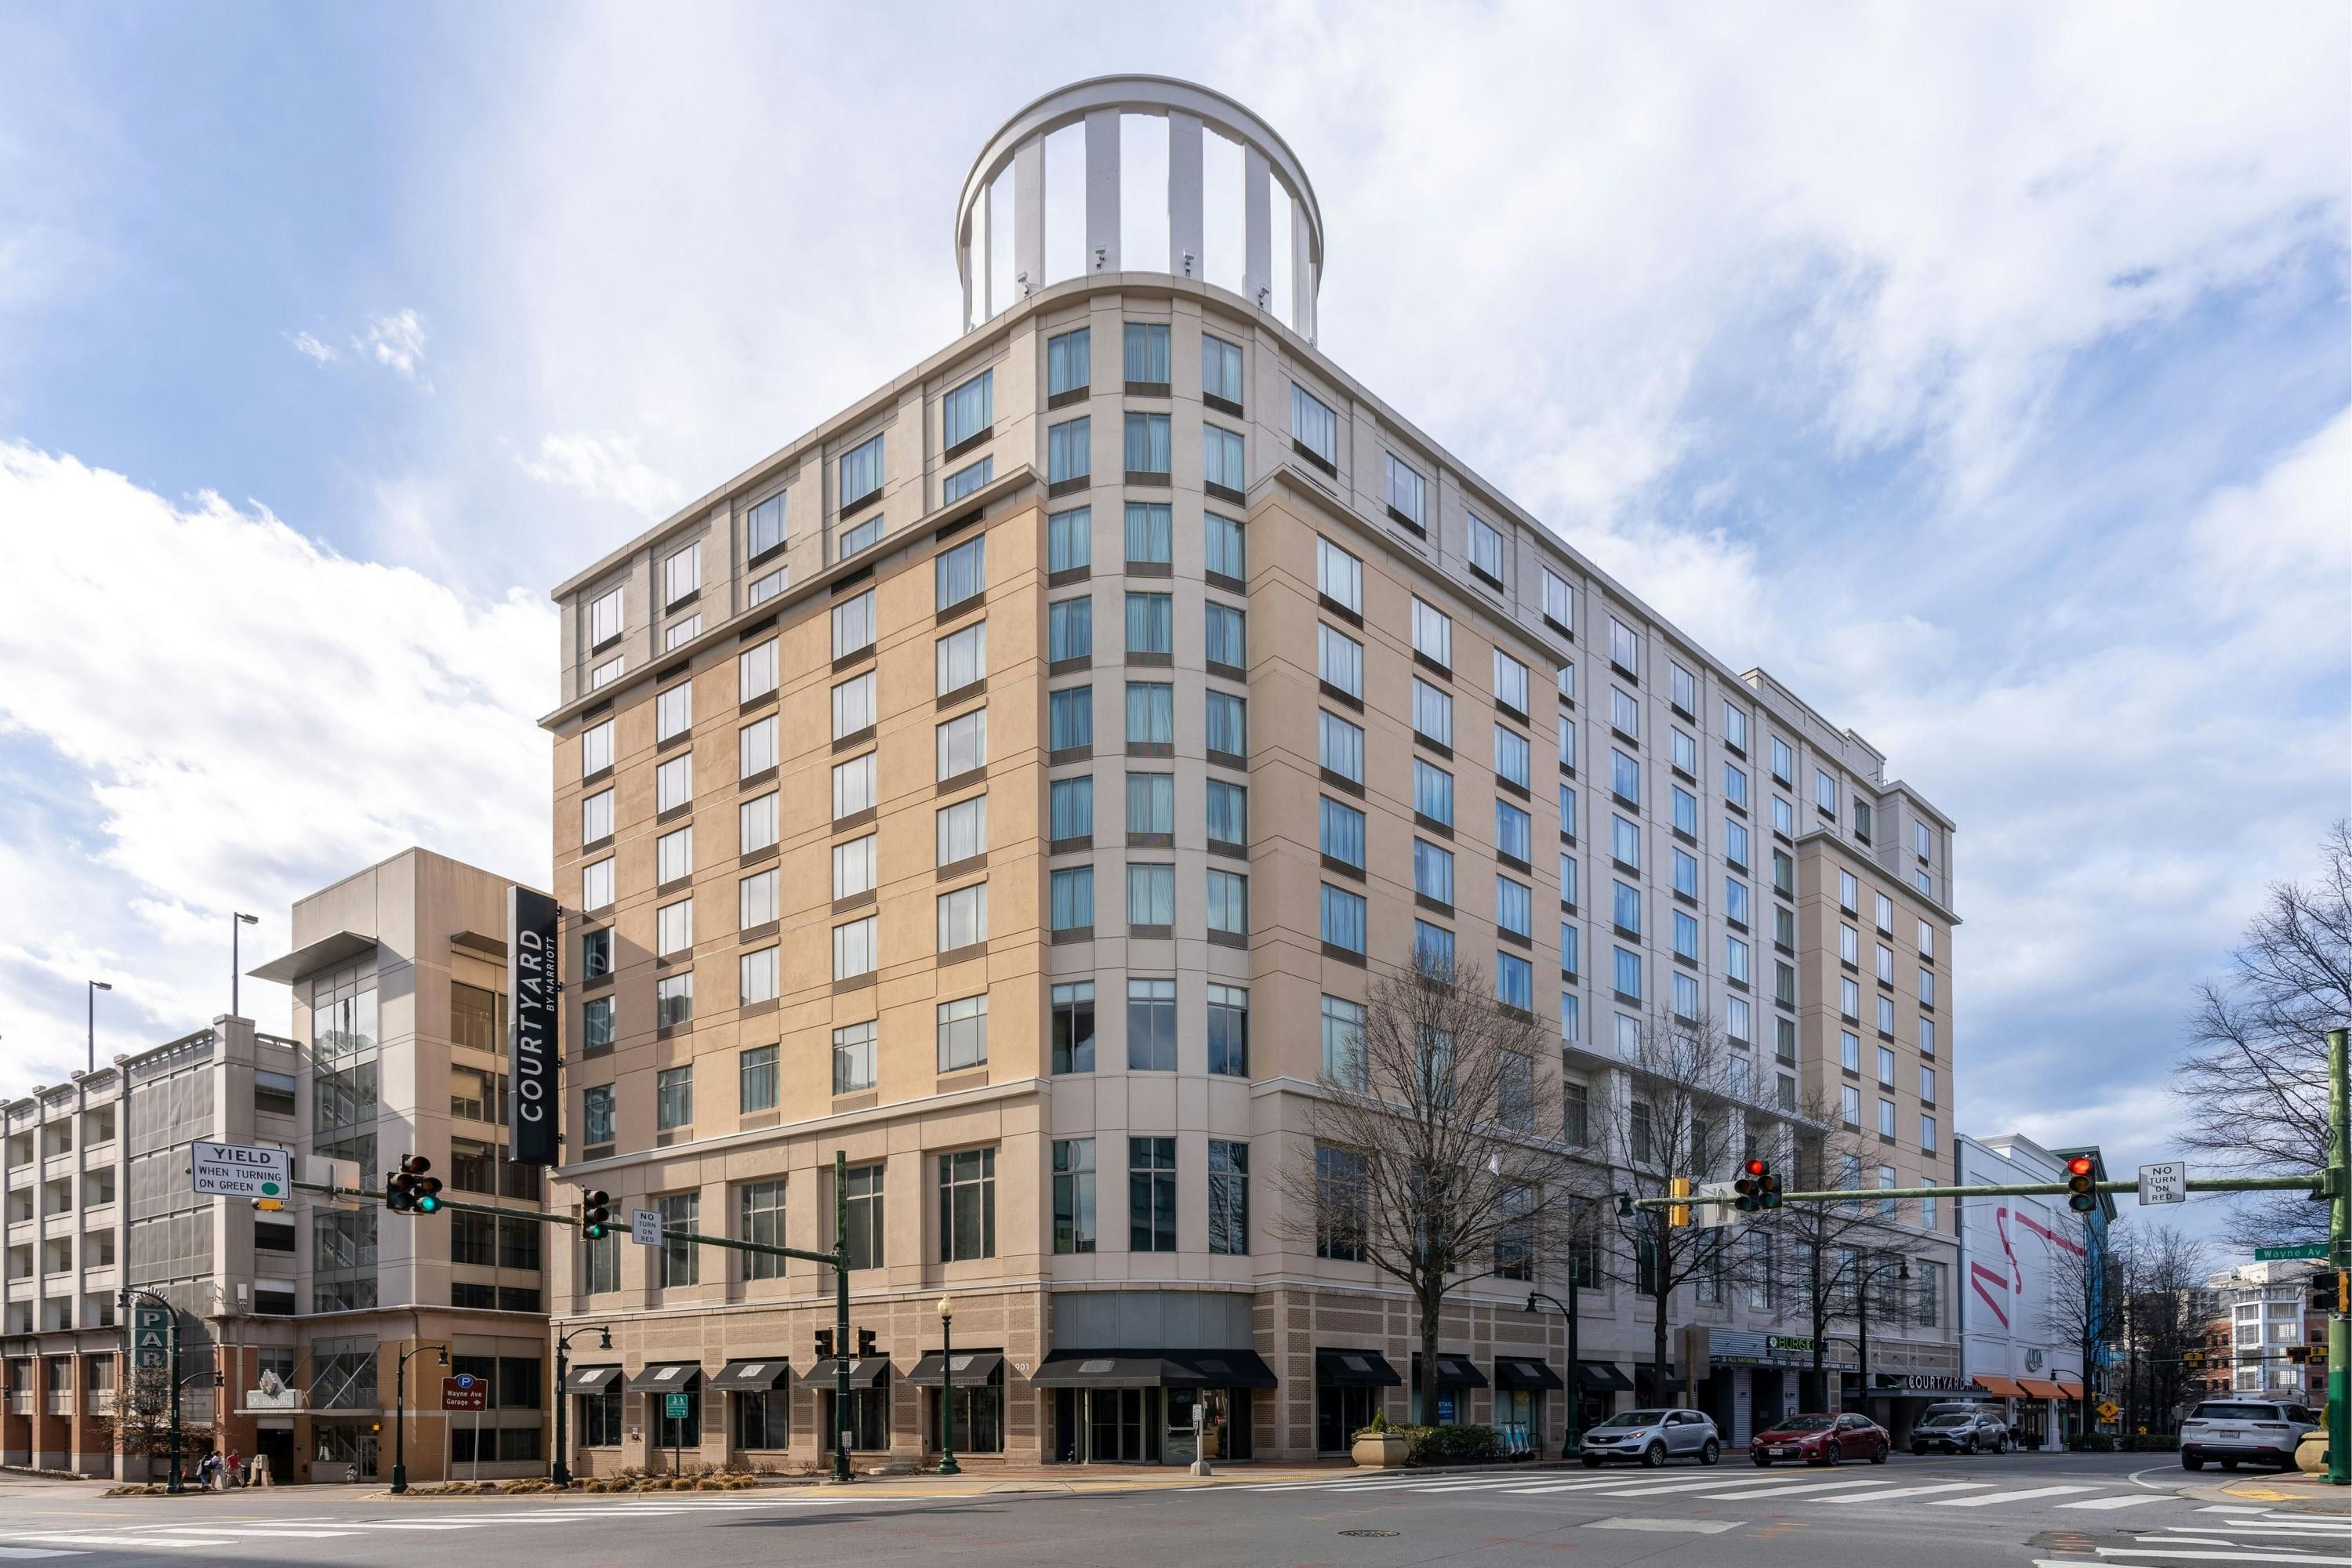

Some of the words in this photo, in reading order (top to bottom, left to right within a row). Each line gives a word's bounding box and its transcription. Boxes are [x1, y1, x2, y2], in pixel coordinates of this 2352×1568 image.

[546, 936, 555, 994] MARRIOTT
[546, 996, 555, 1012] BY
[520, 930, 543, 1122] COURTYARD
[213, 1147, 270, 1163] YIELD
[199, 1166, 229, 1177] WHEN
[236, 1169, 281, 1181] TURNING
[2153, 1167, 2172, 1175] NO
[199, 1179, 214, 1189] ON
[220, 1181, 253, 1192] GREEN
[641, 1212, 654, 1221] NO
[2264, 1250, 2301, 1259] Wayne
[1779, 1337, 1813, 1350] BURGE
[1015, 1363, 1029, 1371] 901
[462, 1377, 470, 1386] P
[1908, 1375, 1965, 1391] COURTYARD
